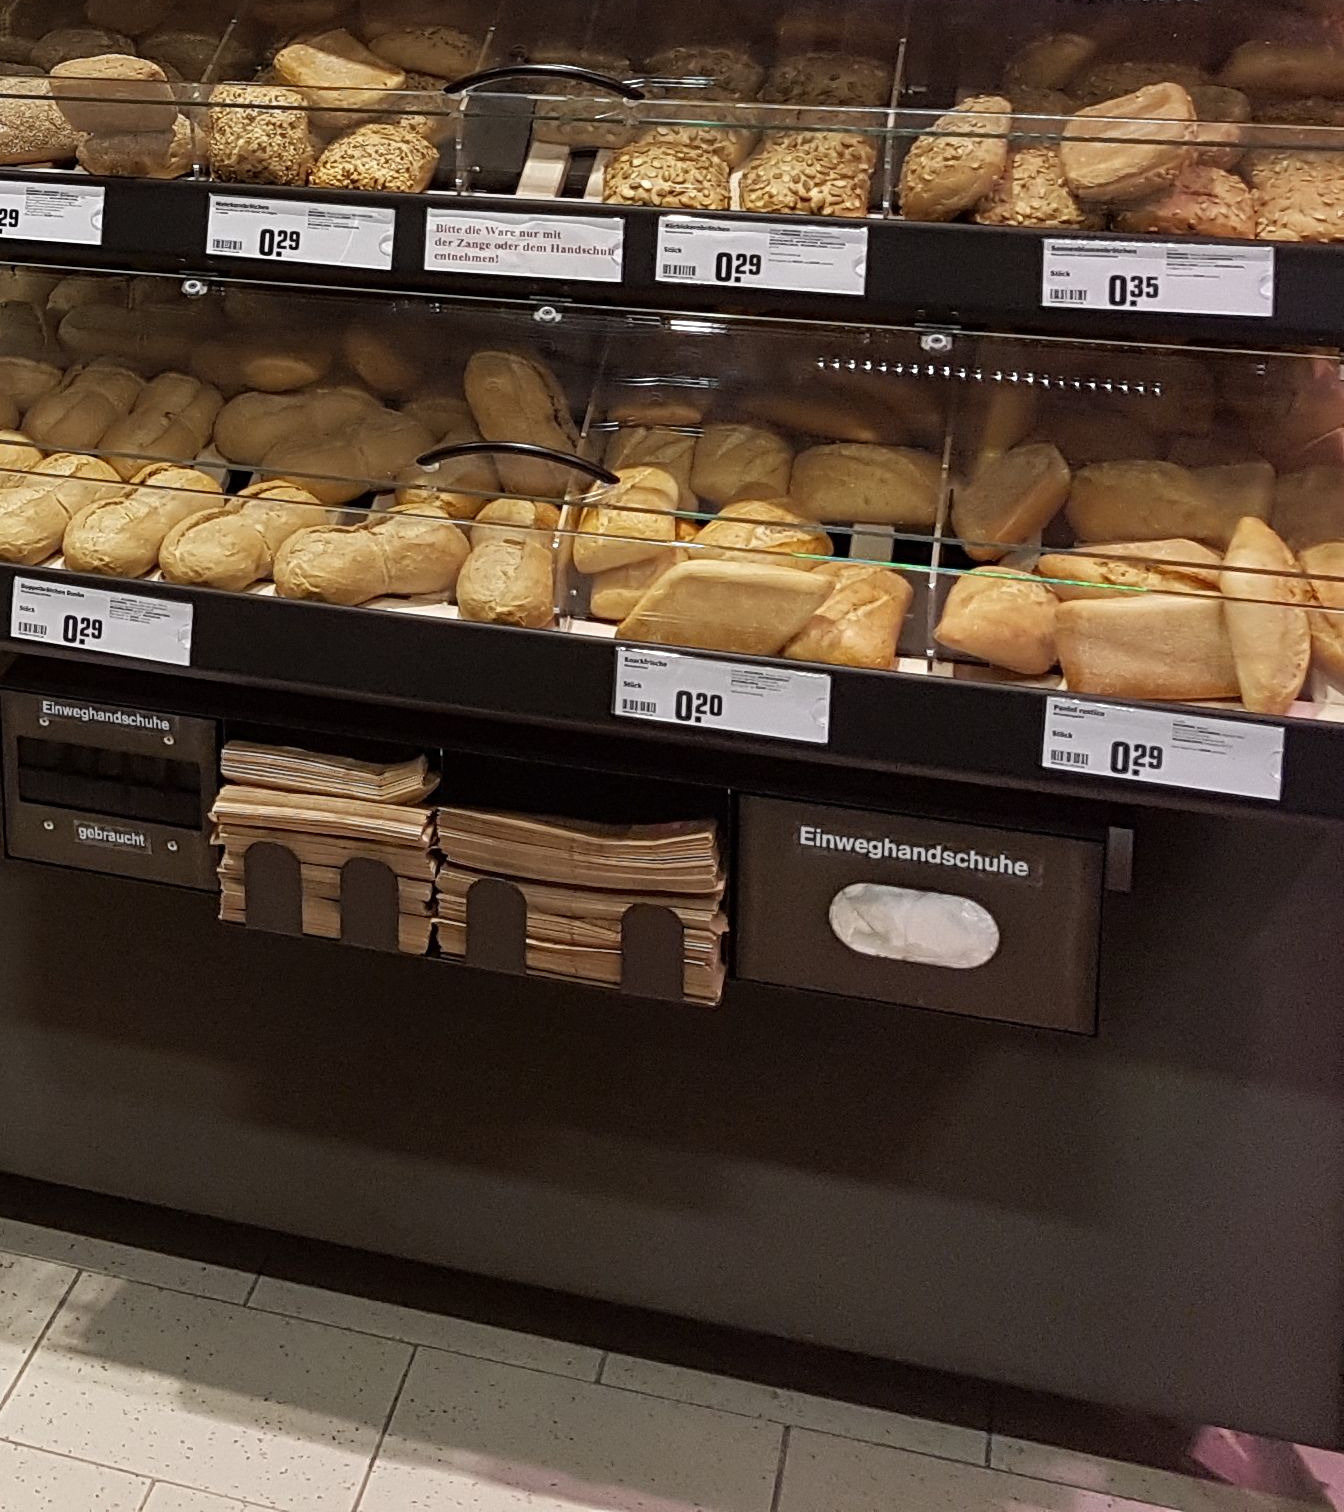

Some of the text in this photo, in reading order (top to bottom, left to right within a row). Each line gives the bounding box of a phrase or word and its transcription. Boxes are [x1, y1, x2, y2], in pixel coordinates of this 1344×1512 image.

[258, 228, 301, 257] 0.29
[434, 237, 454, 248] der
[456, 238, 491, 251] Zange
[494, 240, 520, 252] oder
[522, 242, 547, 254] dem
[435, 223, 562, 240] Bitte die Ware nur mit
[434, 252, 499, 264] entnehmen!
[715, 252, 762, 283] 0.29
[1109, 275, 1160, 307] 0.35
[63, 614, 103, 645] 0.29
[42, 700, 170, 731] Einweghandschuhe
[675, 690, 723, 723] 0.20
[1111, 741, 1164, 777] 0.29
[78, 826, 145, 848] gebraucht
[800, 825, 1029, 877] Einweghandschuhe
